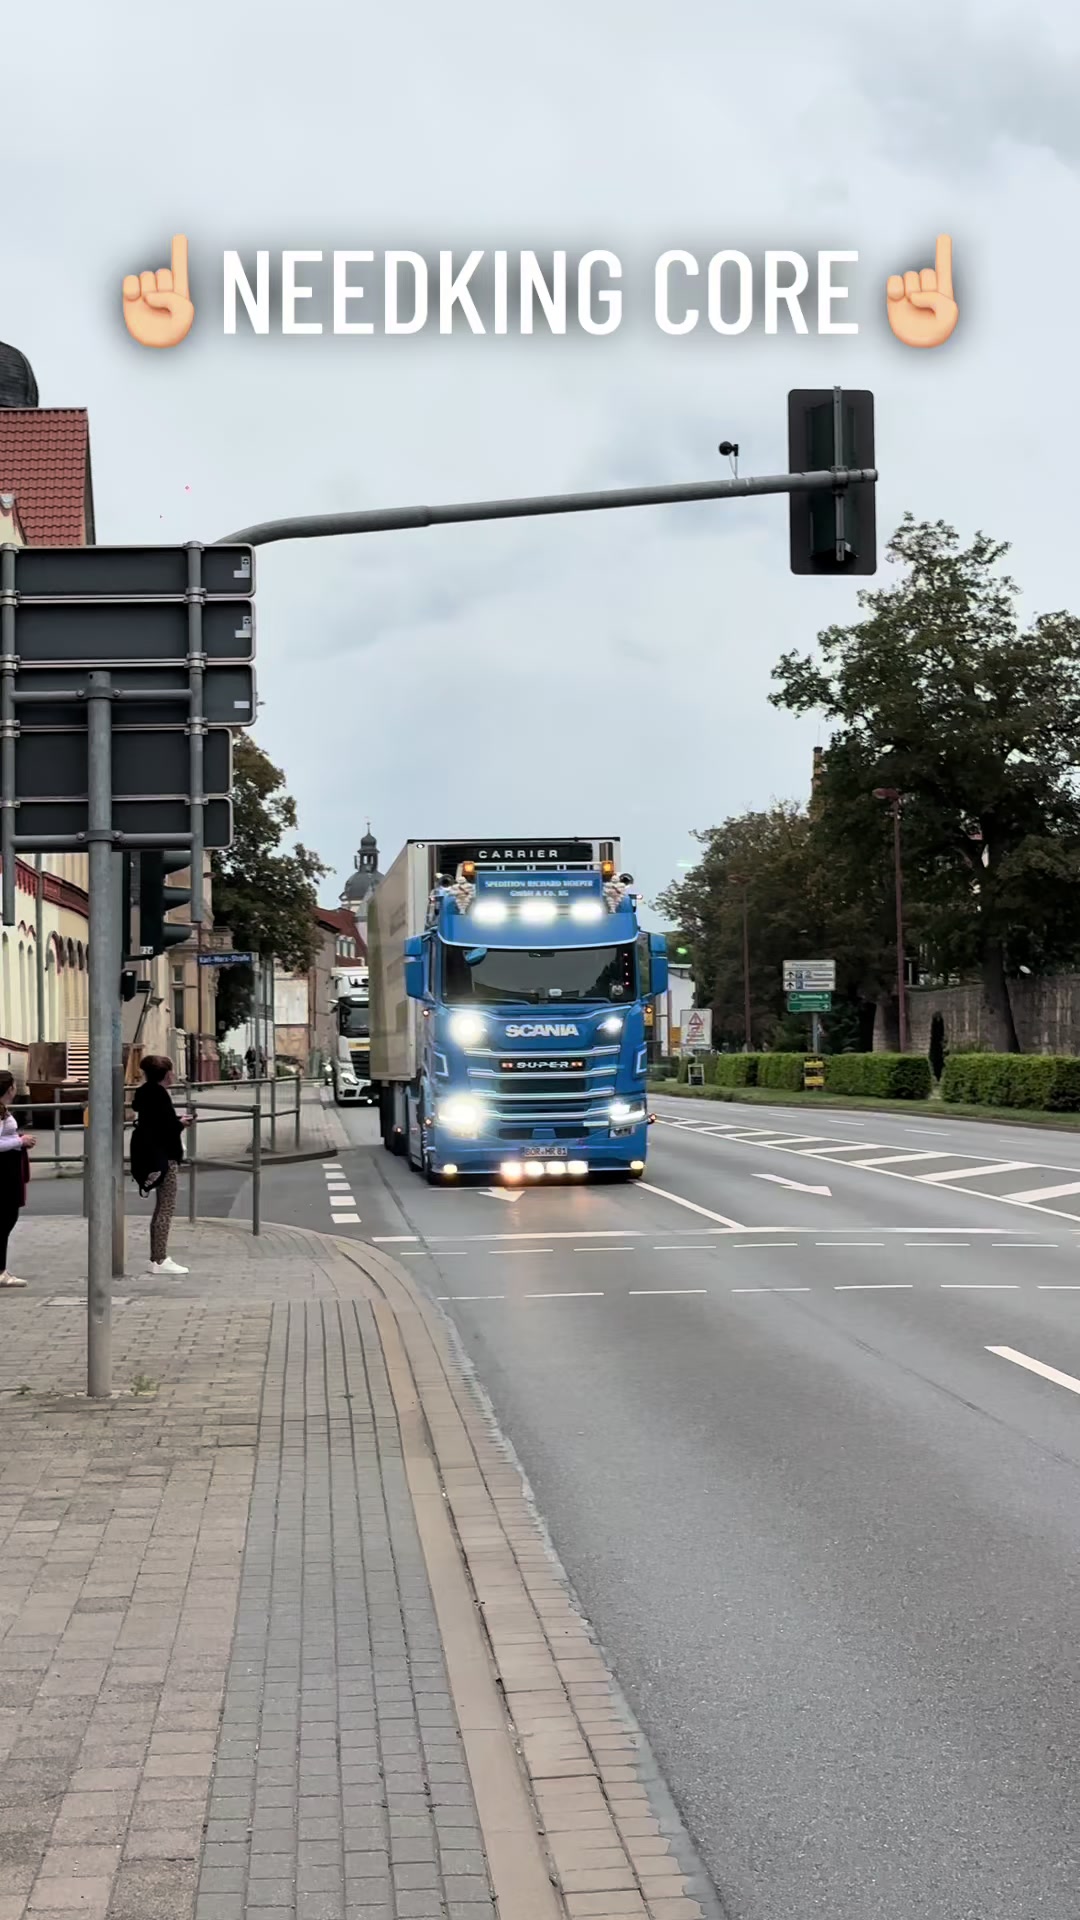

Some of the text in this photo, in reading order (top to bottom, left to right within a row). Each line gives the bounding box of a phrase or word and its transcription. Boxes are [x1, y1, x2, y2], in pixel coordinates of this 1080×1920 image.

[478, 850, 558, 858] CARRIER
[485, 880, 525, 888] SPEDITION
[505, 1024, 579, 1037] SCANIA
[516, 1061, 569, 1069] SUPER
